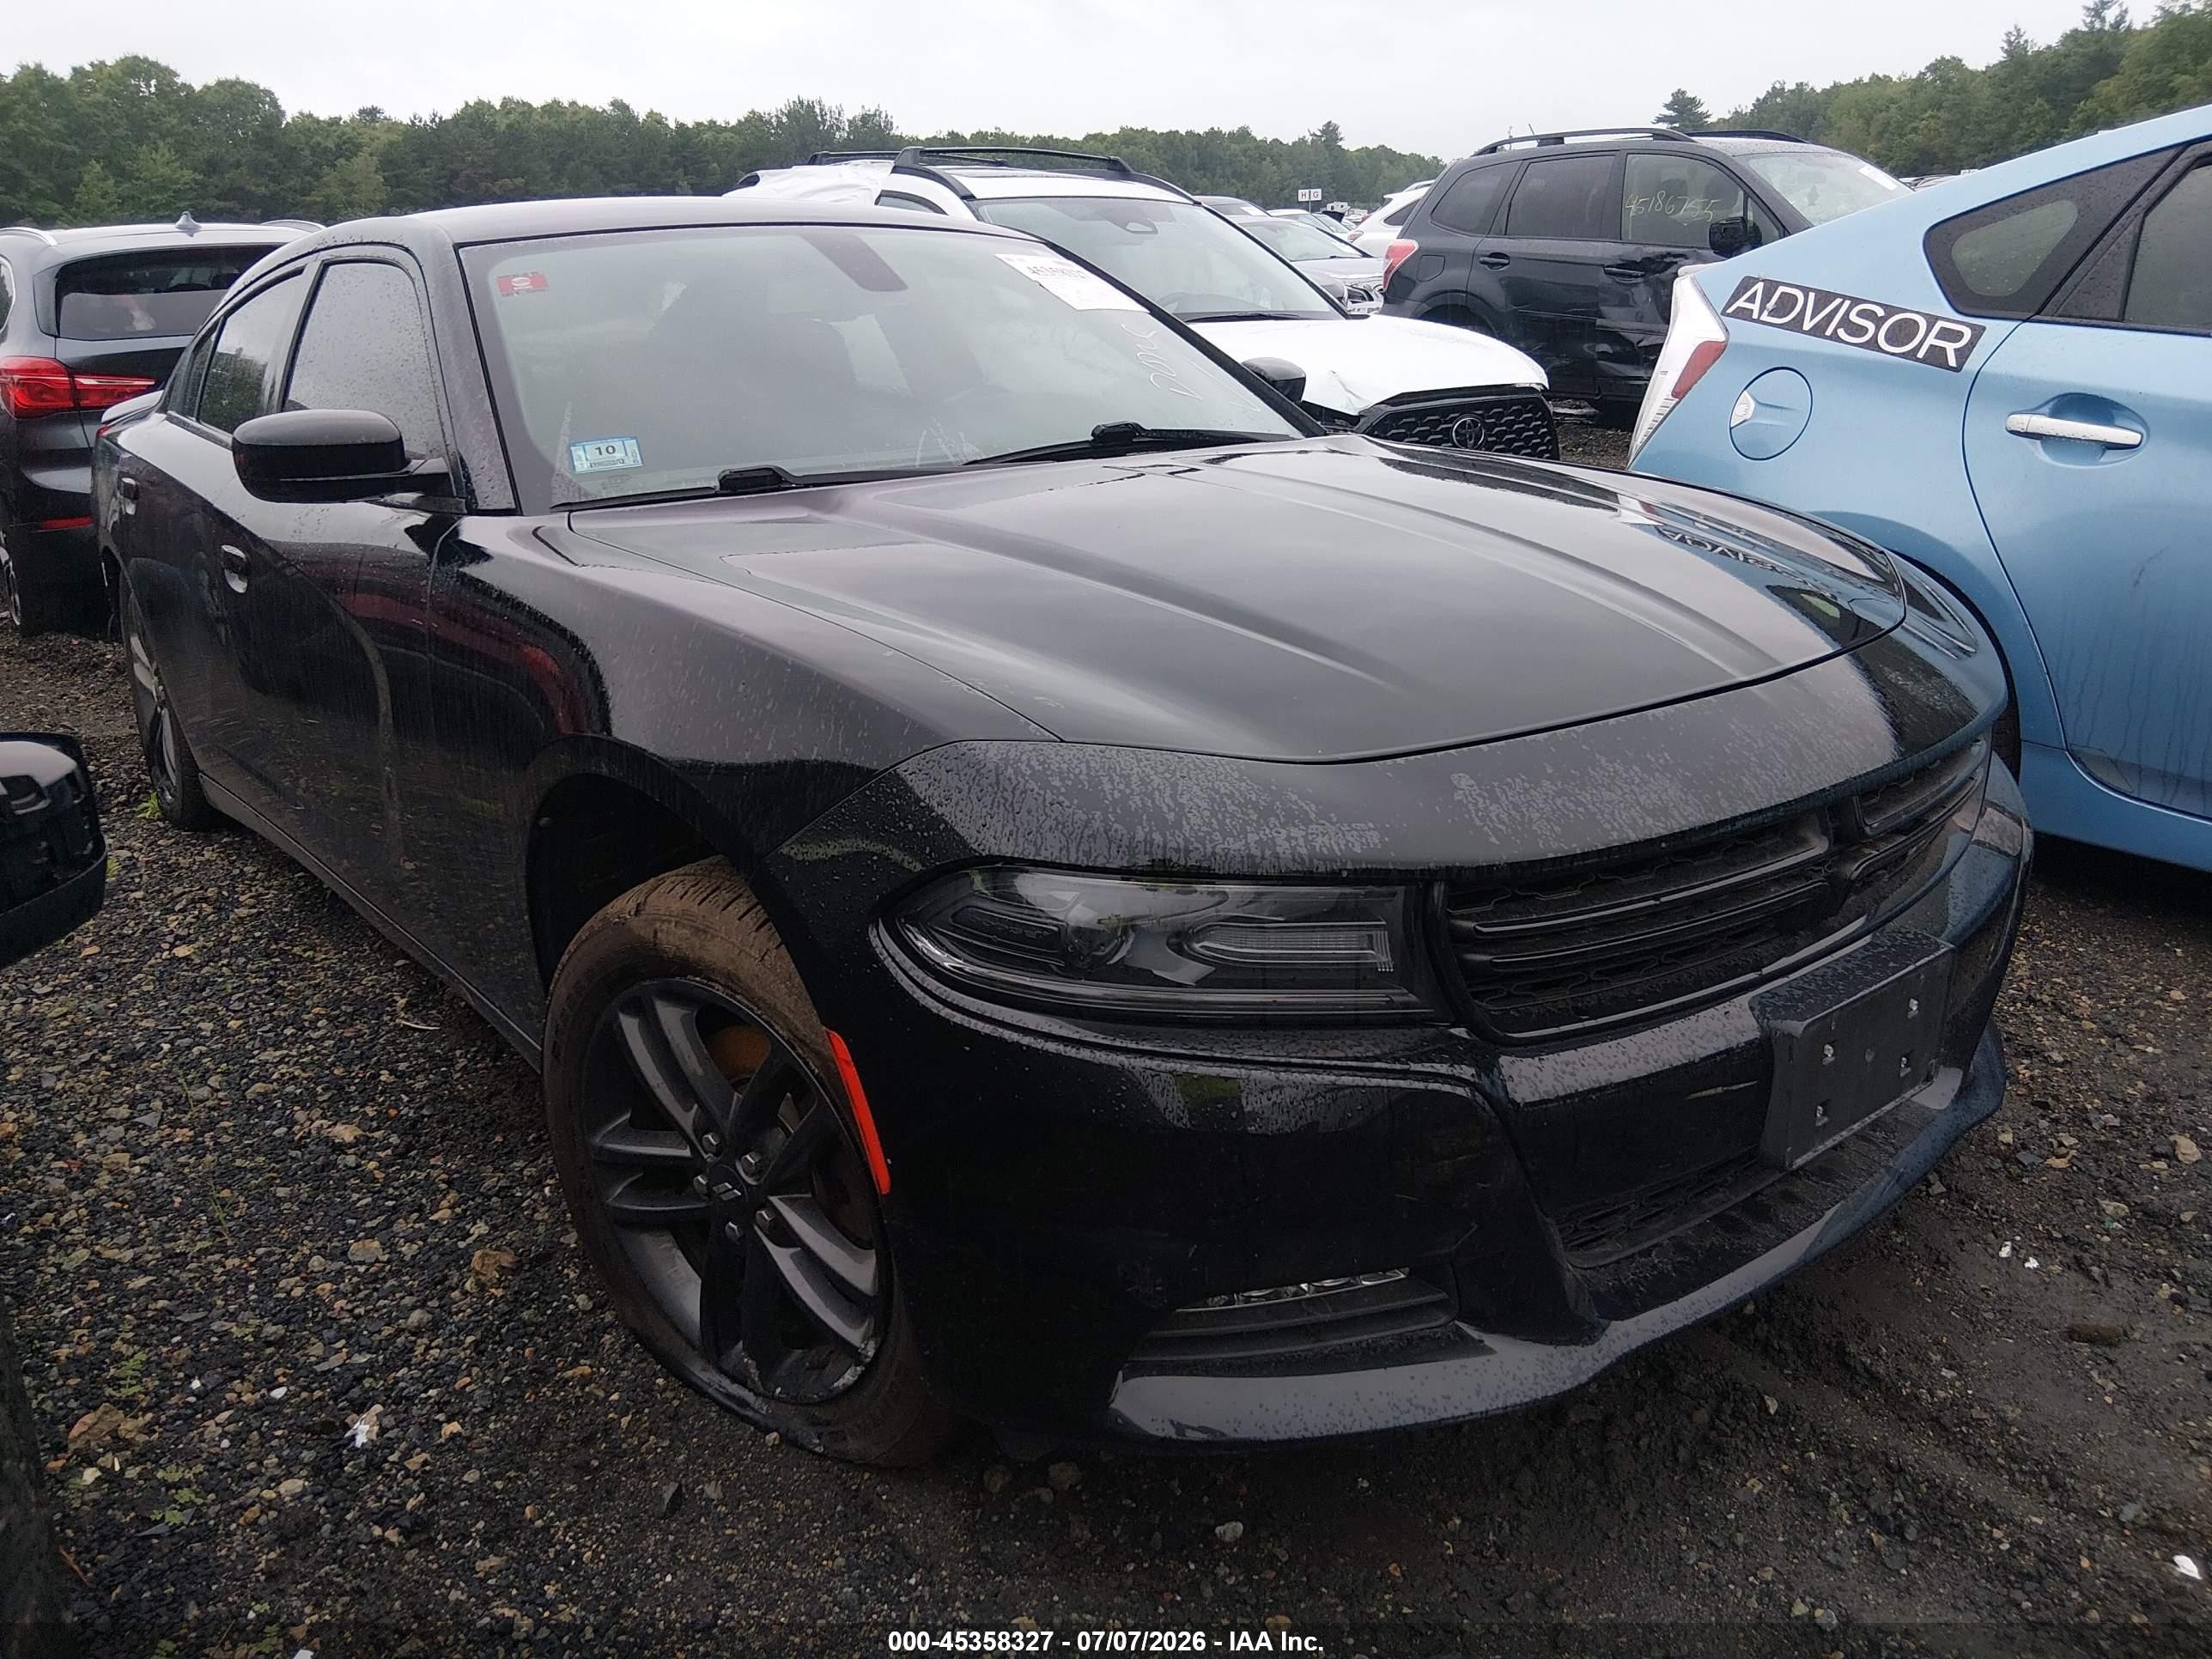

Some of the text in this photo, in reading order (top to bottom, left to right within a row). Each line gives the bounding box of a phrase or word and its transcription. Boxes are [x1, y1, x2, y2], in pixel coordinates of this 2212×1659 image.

[1625, 191, 1722, 222] 45186755
[1725, 281, 1972, 368] ADVISOR
[594, 445, 617, 456] 10
